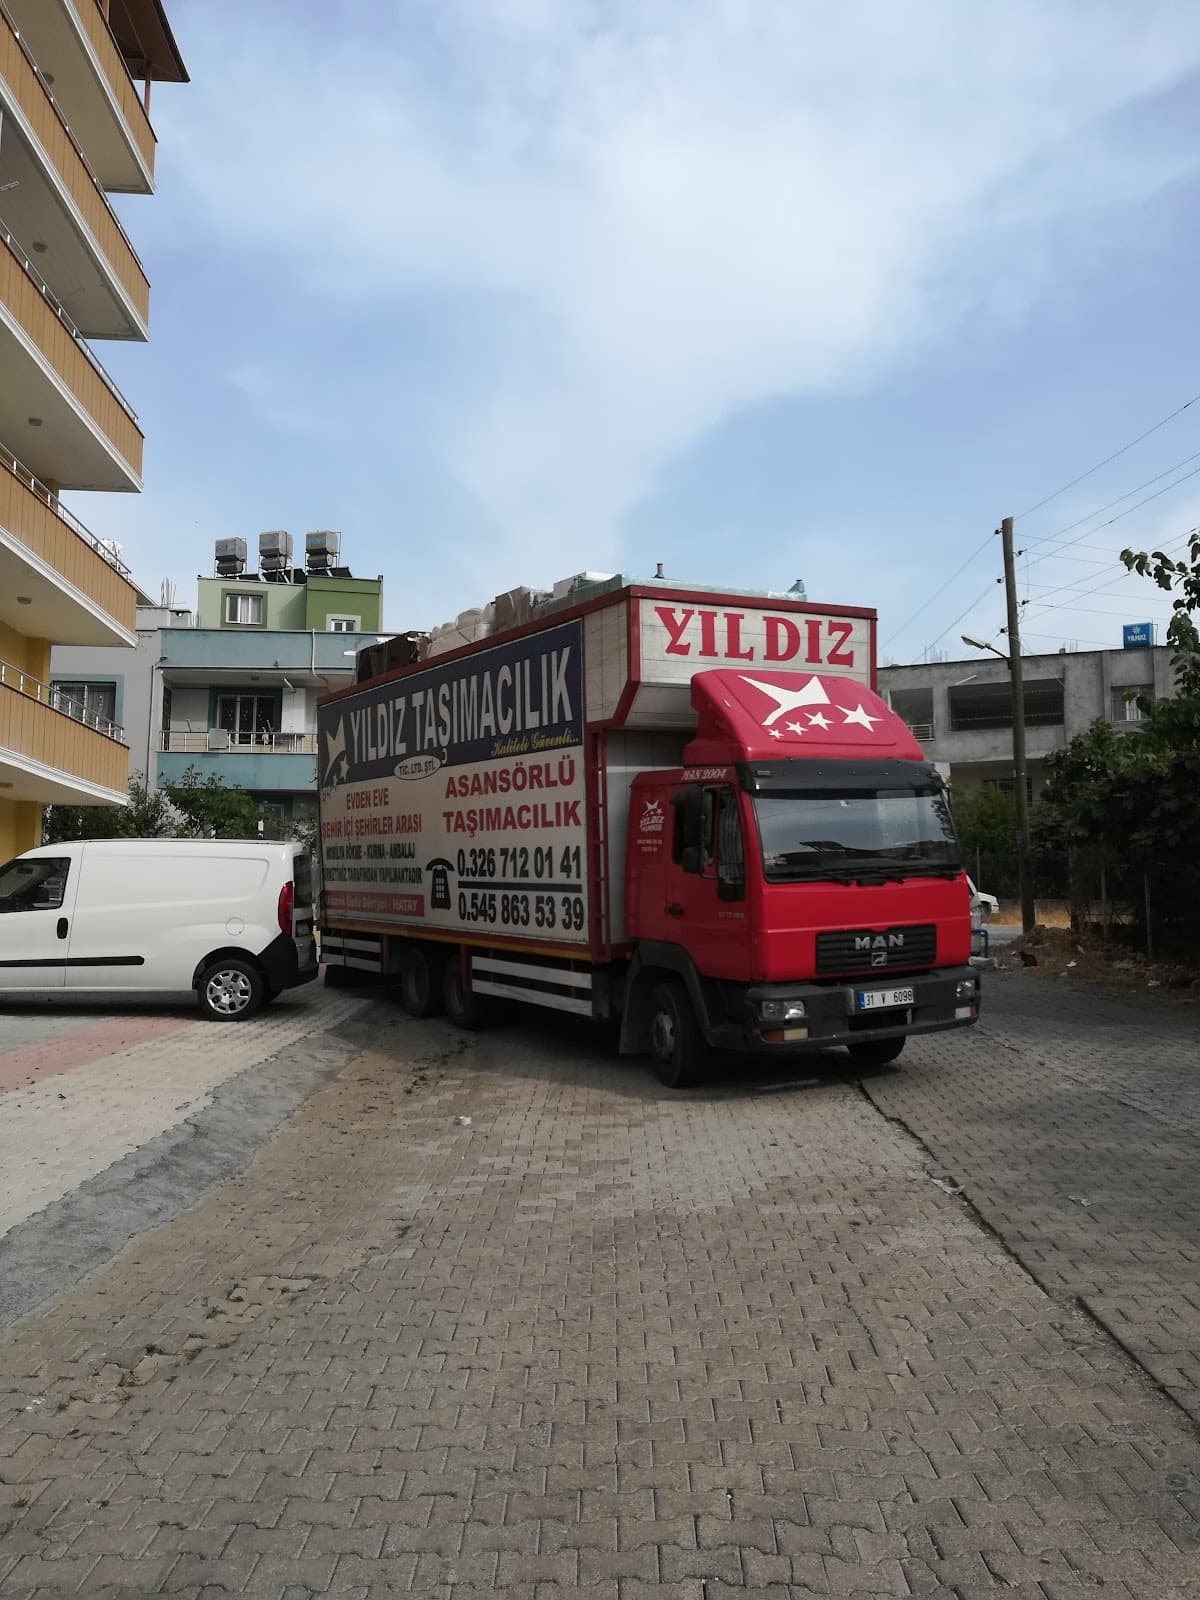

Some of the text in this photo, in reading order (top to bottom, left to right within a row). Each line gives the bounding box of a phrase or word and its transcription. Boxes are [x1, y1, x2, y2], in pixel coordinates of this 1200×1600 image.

[655, 606, 854, 668] YILDIZ
[351, 647, 573, 764] YILDIZ TAŞIMACILIK
[445, 754, 575, 799] ASANSÖRLÜ
[701, 768, 728, 779] 2004
[346, 787, 389, 810] EVDEN EVE
[343, 815, 353, 841] İÇİ
[355, 814, 393, 840] ŞEHİRLER
[395, 813, 422, 833] ARASI
[443, 800, 581, 838] TAŞIMACILIK
[457, 845, 581, 879] 0.326 712 01 41
[459, 892, 584, 931] 0.545 863 53 39
[855, 934, 904, 950] MAN
[866, 990, 913, 1006] 31 V 6098
